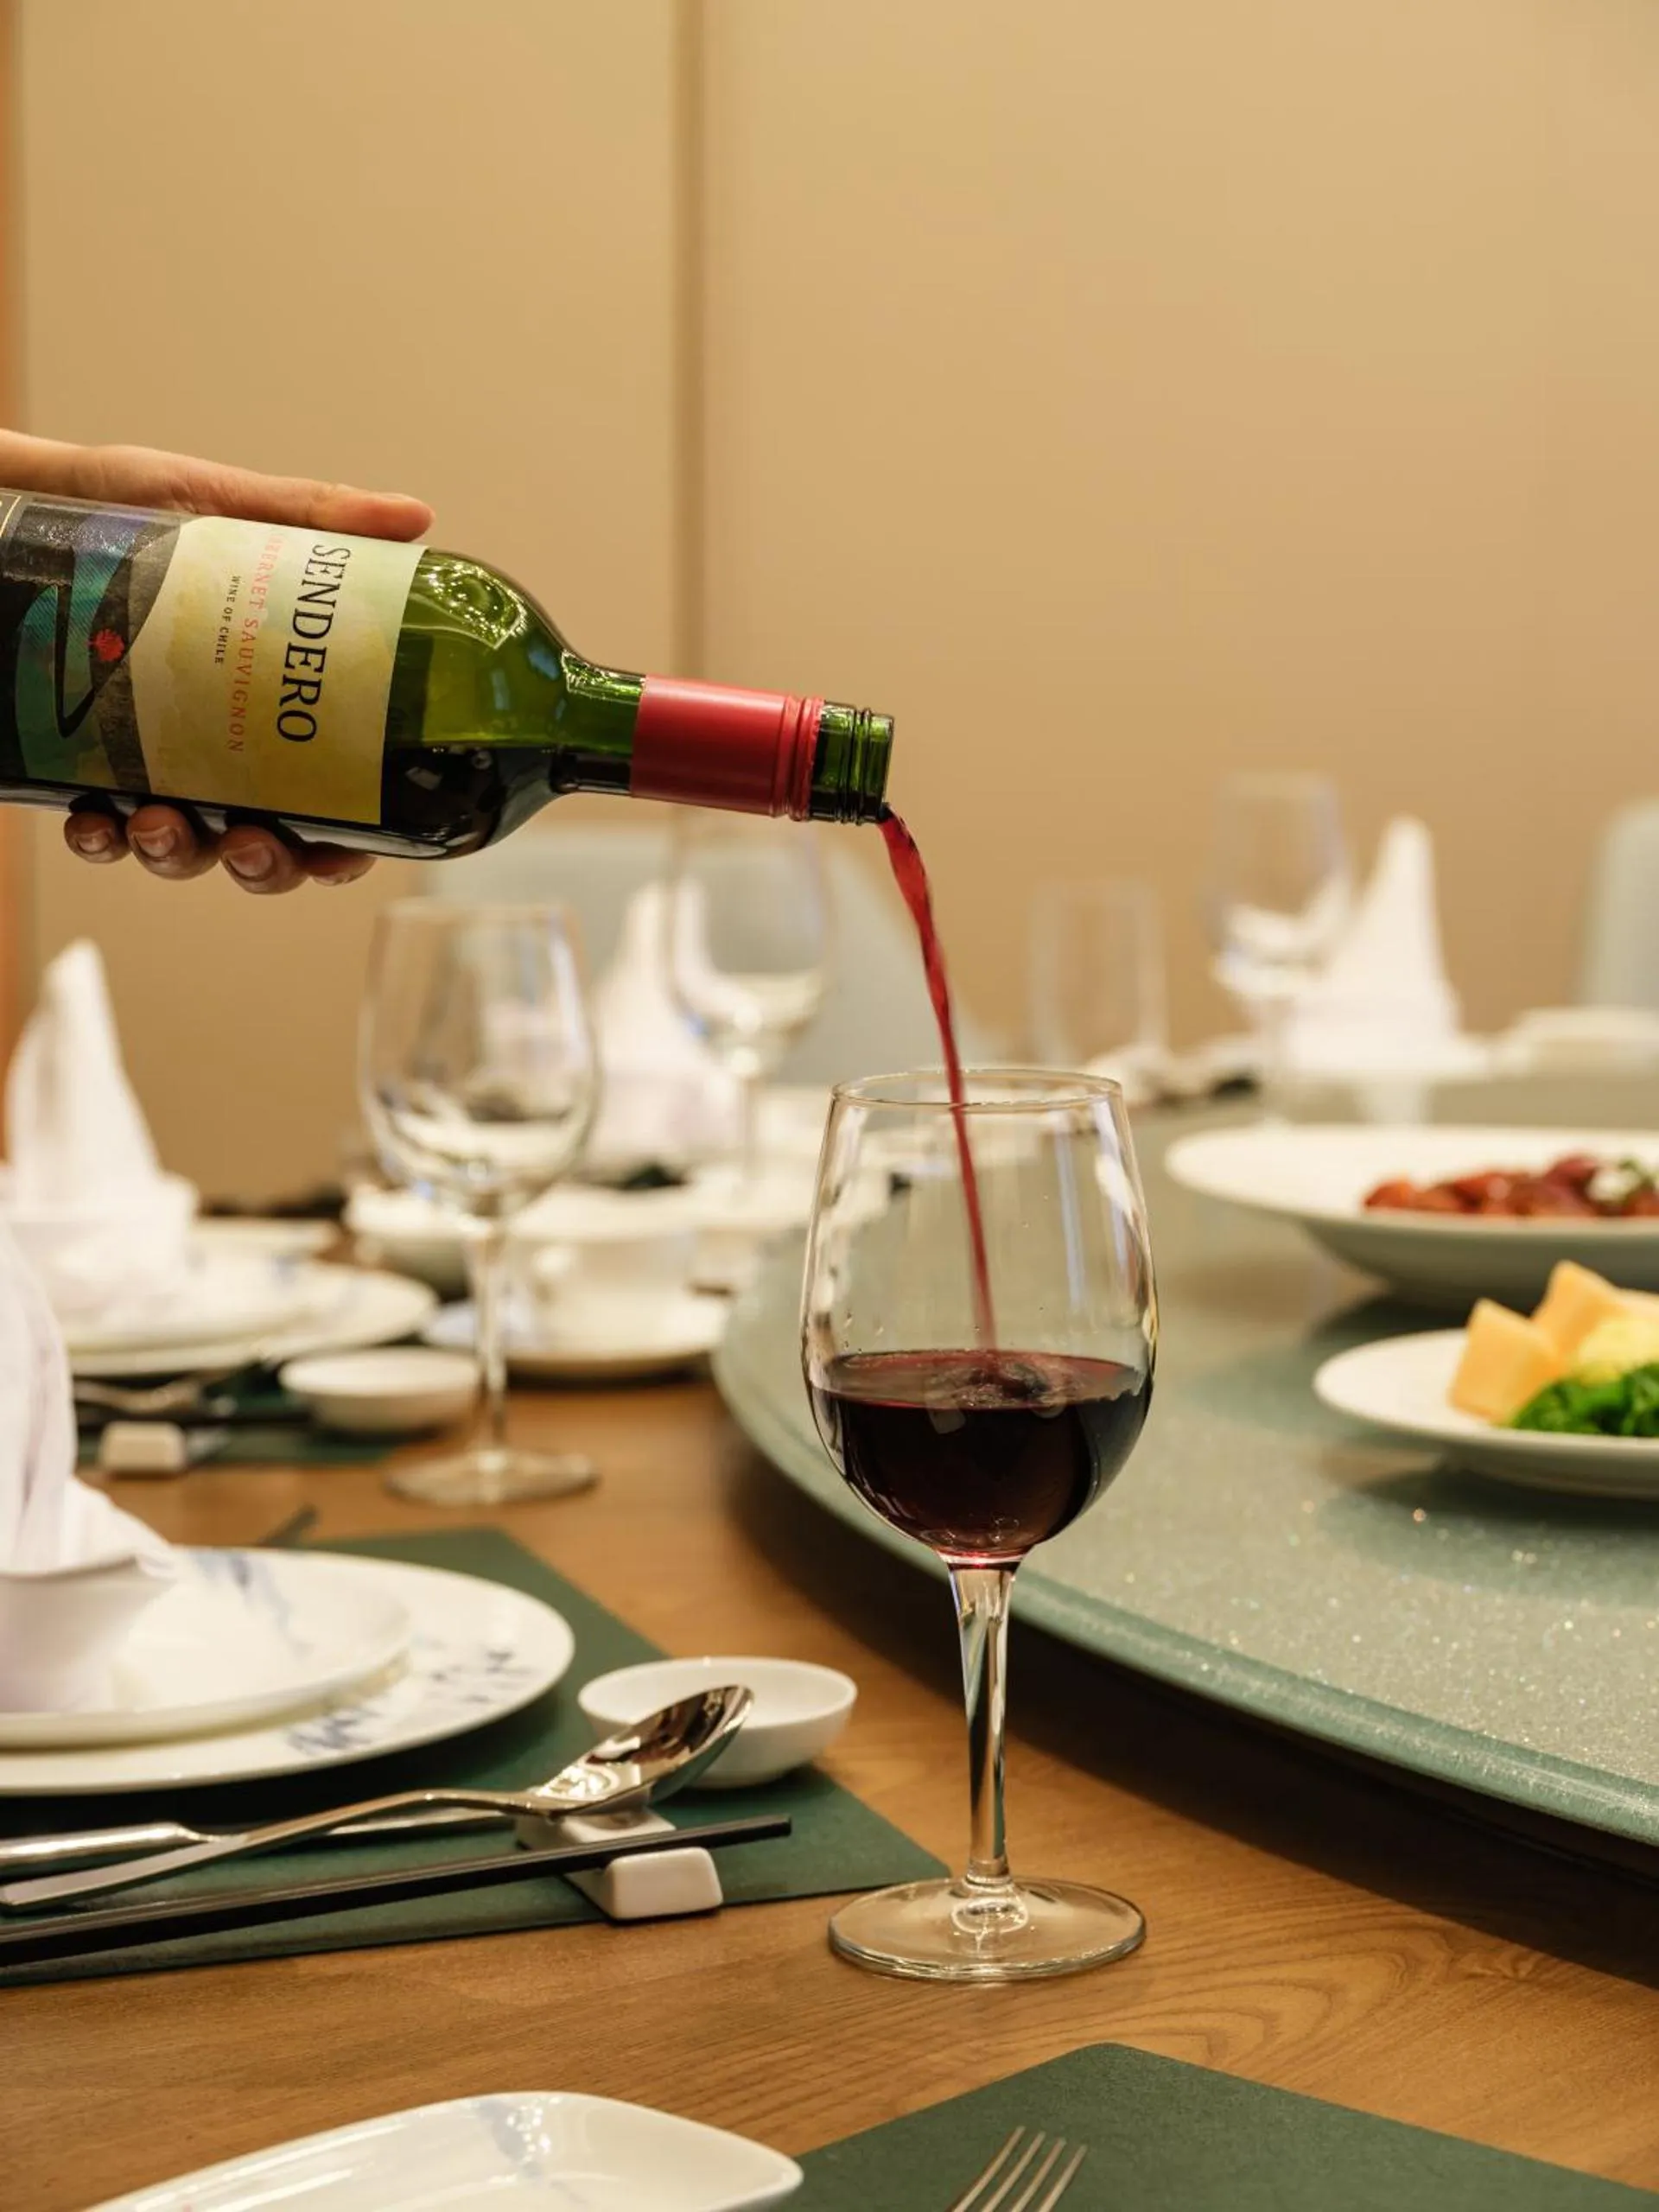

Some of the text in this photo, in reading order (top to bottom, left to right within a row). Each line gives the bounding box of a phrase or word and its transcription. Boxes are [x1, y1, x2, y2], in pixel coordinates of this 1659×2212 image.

[214, 575, 242, 664] WINE OF CHILE
[228, 535, 283, 753] BERNET SAUVIGNON
[276, 544, 351, 742] SENDERO
